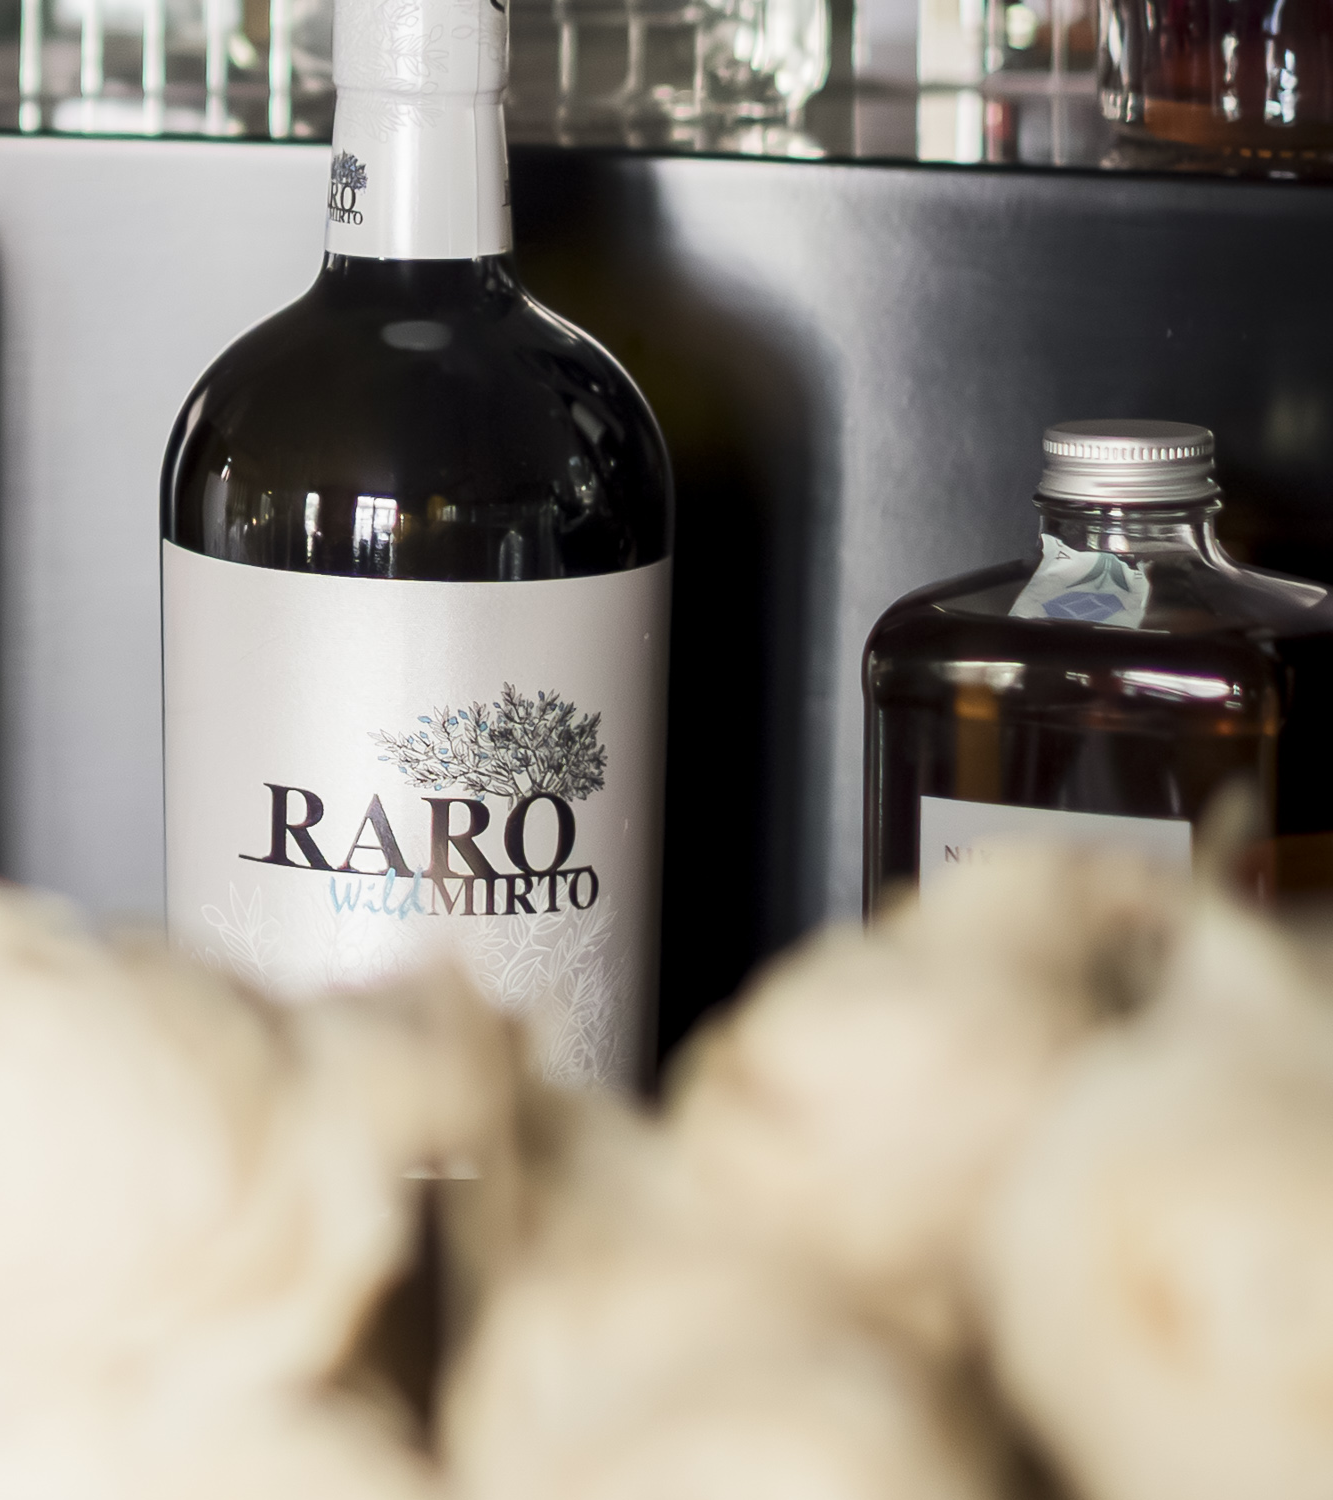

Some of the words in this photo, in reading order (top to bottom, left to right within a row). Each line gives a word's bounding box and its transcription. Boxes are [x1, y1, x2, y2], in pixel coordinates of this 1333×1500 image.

[253, 782, 577, 878] RARO
[329, 867, 425, 919] Wild
[427, 865, 599, 916] MIRTO
